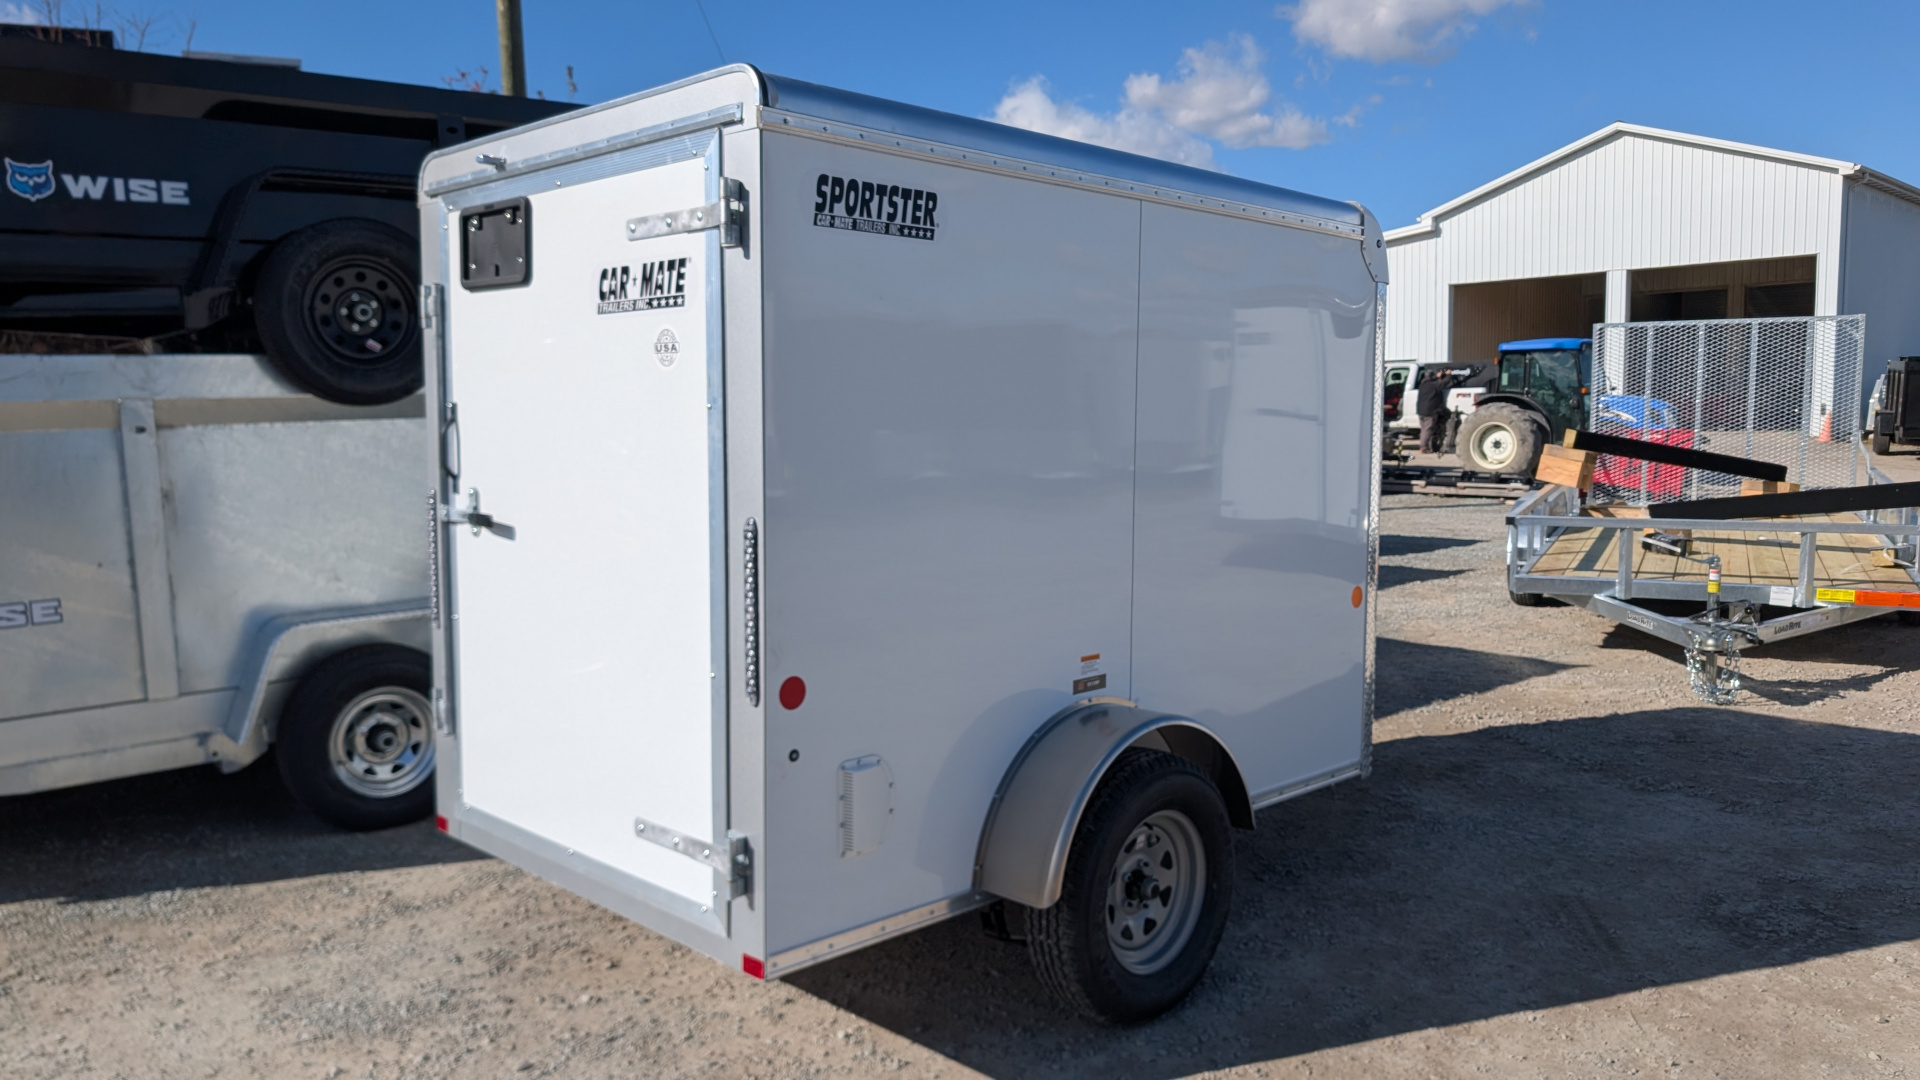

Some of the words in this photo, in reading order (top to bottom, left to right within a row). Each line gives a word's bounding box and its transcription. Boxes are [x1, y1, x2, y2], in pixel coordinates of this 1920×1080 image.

[60, 173, 190, 205] WISE
[815, 174, 938, 228] SPORTSTER
[856, 219, 886, 233] TRAILERS
[599, 265, 630, 302] CAR
[640, 257, 687, 298] MATE
[599, 300, 634, 313] TRAILERS
[655, 343, 678, 353] USA
